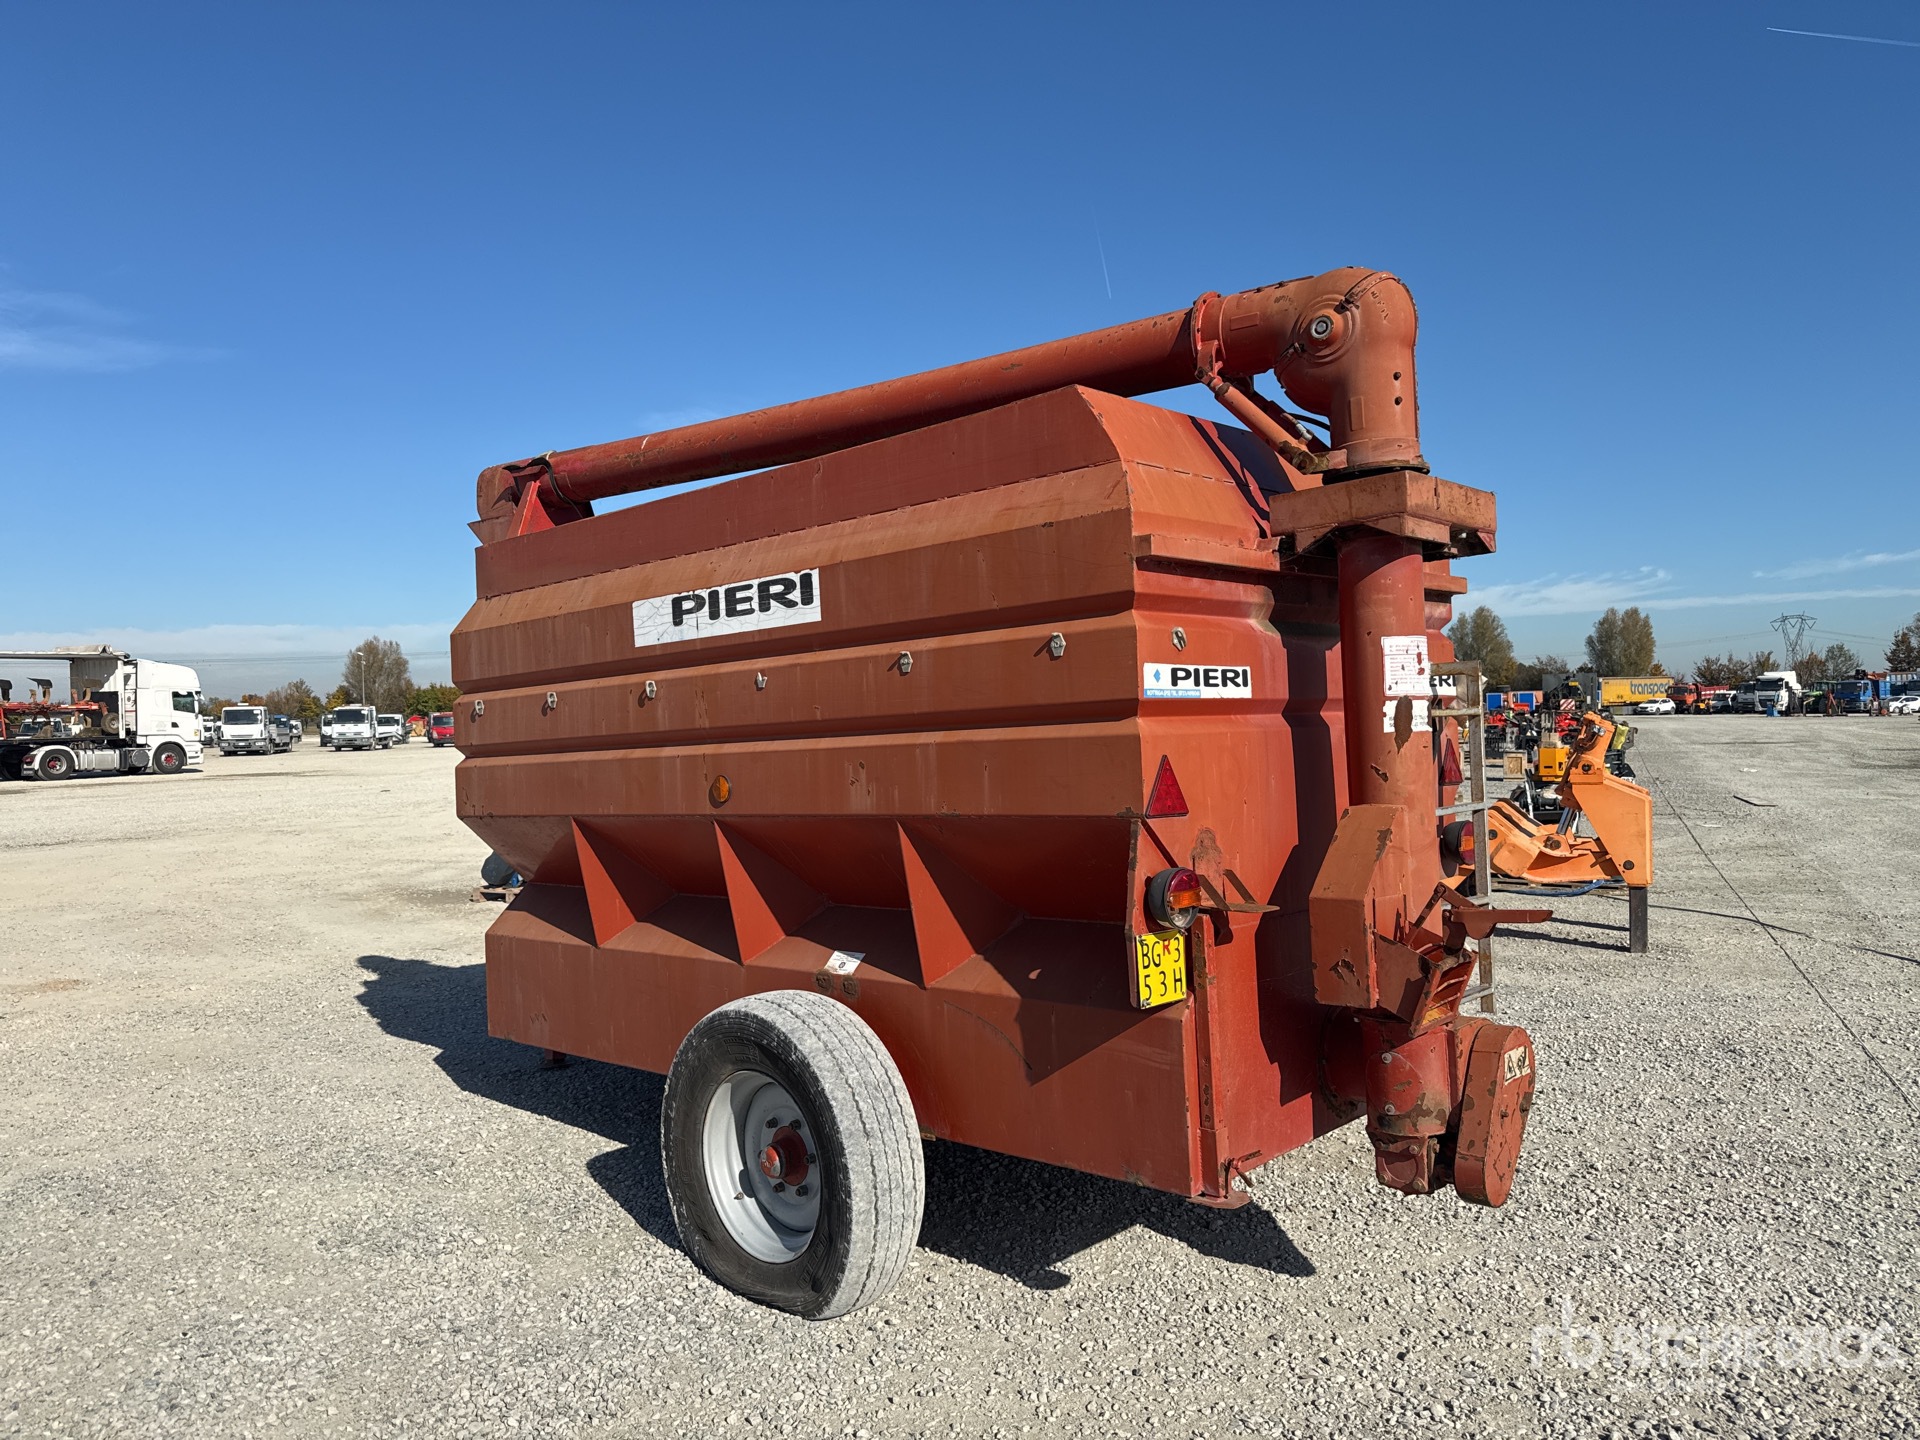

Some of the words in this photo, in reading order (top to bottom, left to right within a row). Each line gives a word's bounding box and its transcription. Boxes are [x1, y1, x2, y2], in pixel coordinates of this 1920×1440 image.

[671, 572, 815, 627] PIERI
[1170, 667, 1249, 688] PIERI
[1429, 674, 1457, 687] ERI
